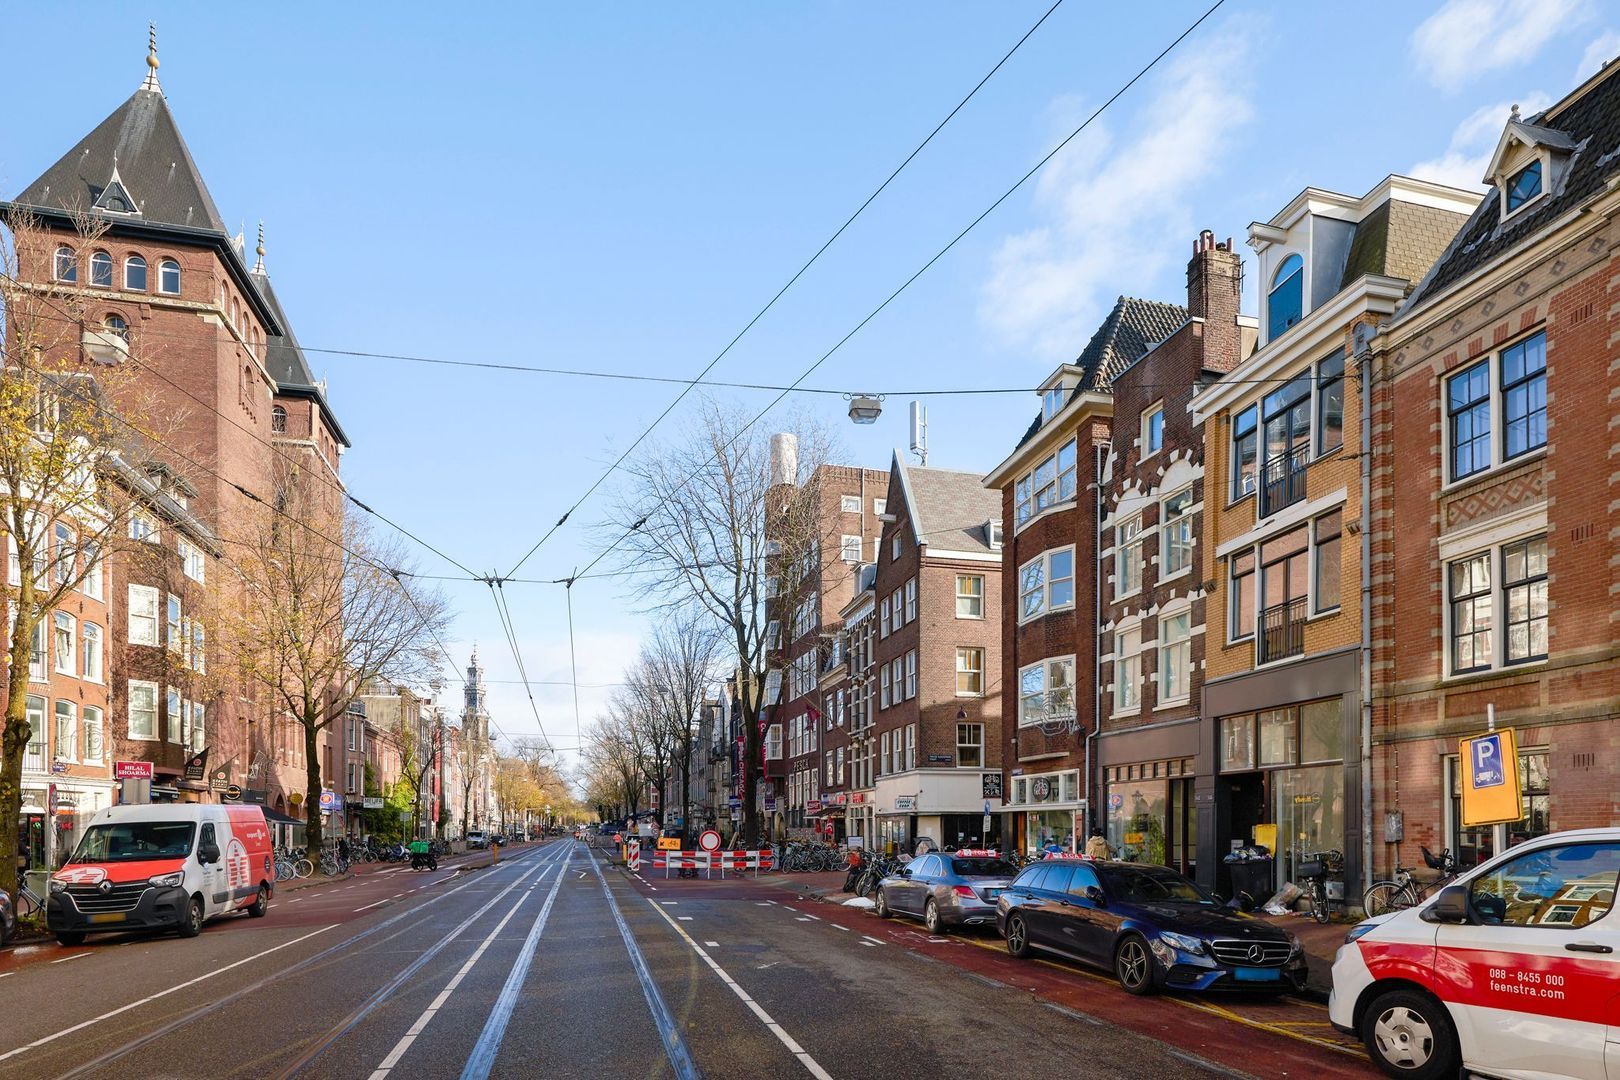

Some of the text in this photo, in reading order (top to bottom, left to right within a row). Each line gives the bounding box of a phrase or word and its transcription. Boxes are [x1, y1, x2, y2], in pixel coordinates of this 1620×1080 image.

[1477, 741, 1494, 768] P
[1489, 968, 1506, 979] 088
[1517, 971, 1541, 983] 8455
[1545, 975, 1564, 986] 000
[1490, 980, 1565, 1000] feenstra.com
